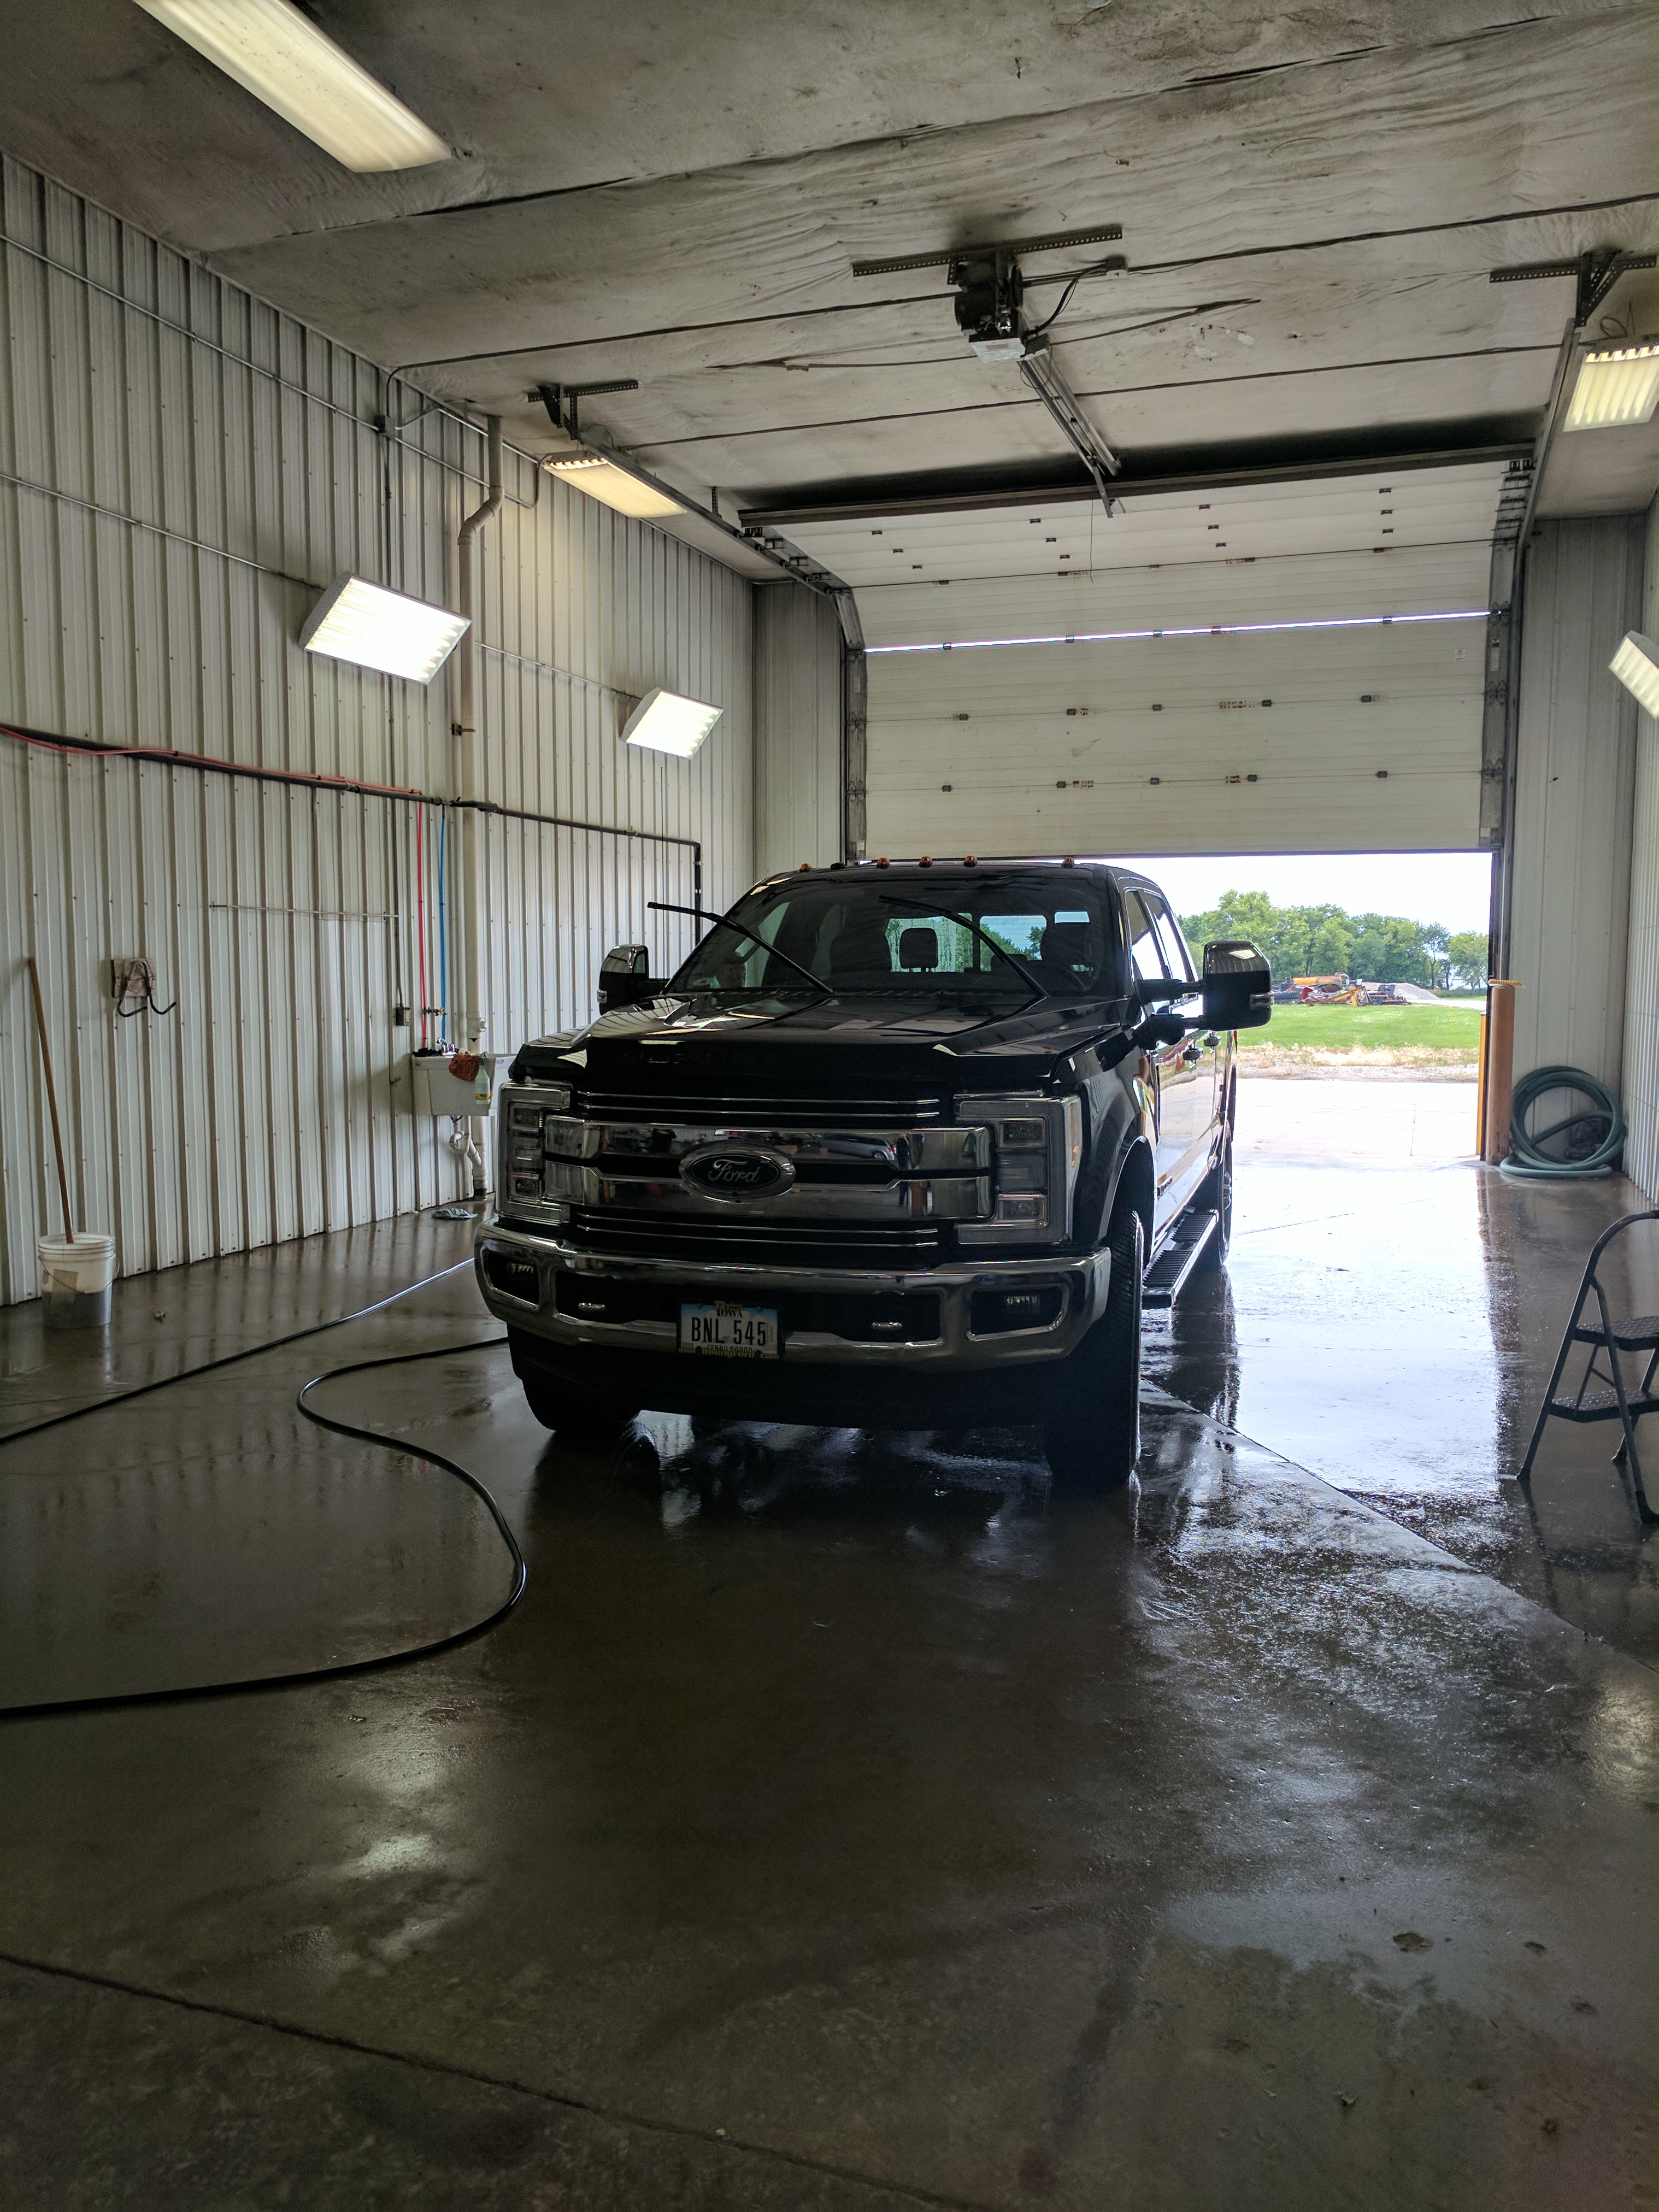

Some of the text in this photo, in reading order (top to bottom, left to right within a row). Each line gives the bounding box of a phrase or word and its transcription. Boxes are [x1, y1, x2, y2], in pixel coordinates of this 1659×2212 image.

[708, 1159, 760, 1183] Ford
[691, 1317, 766, 1346] BNL 545
